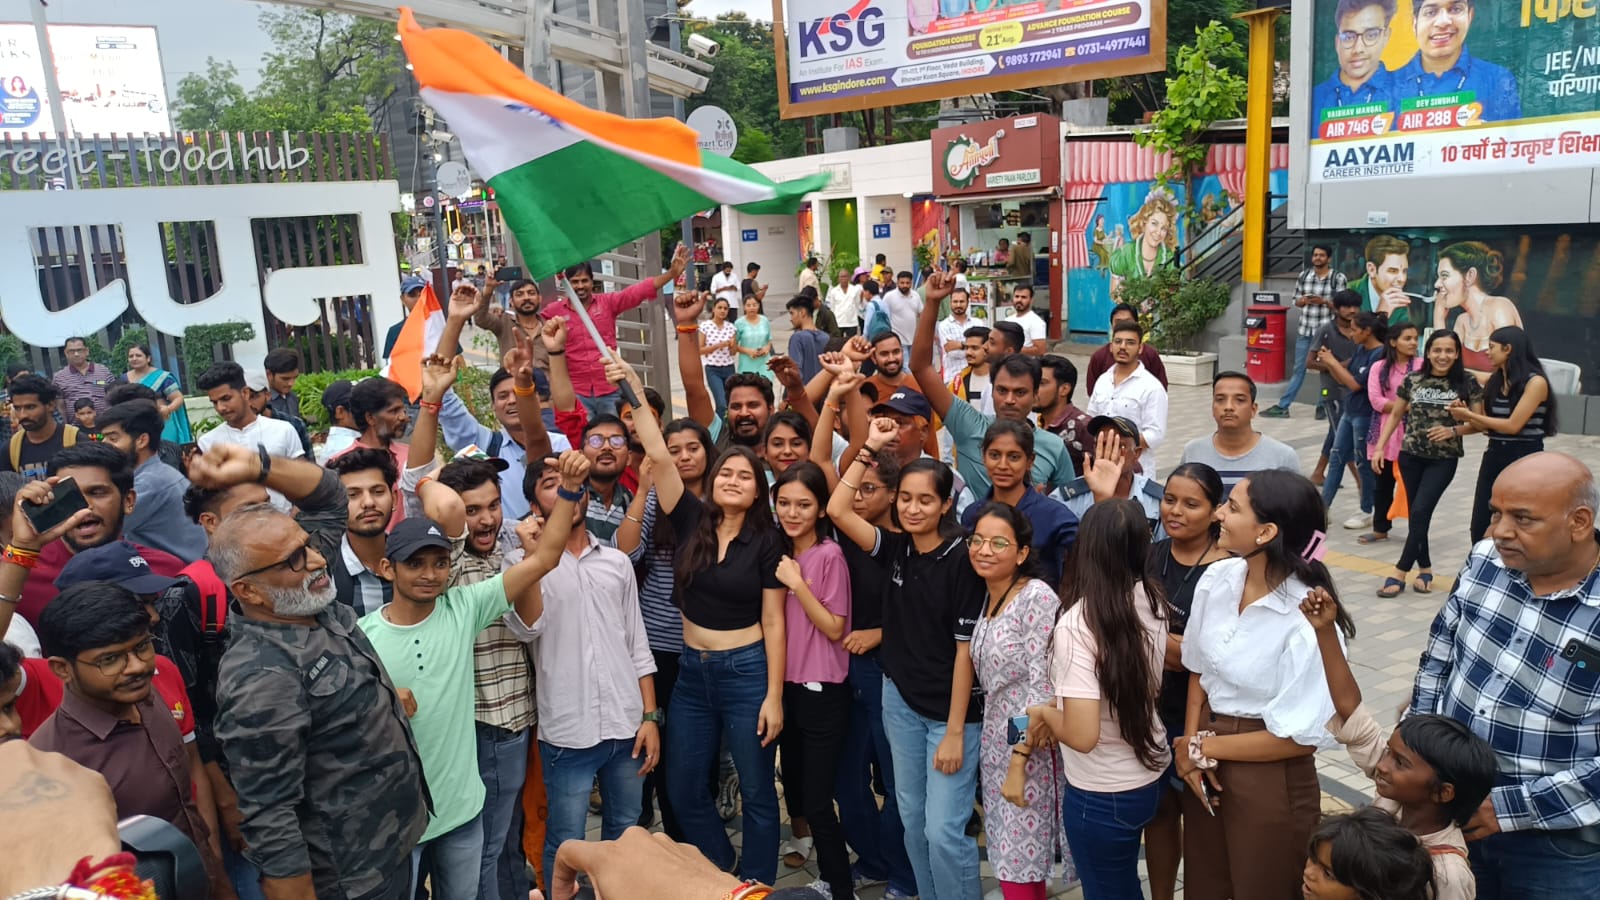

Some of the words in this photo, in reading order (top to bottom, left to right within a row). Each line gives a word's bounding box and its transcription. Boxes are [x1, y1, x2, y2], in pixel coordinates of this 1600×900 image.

[1026, 21, 1058, 32] ADVANCE
[1058, 11, 1101, 26] FOUNDATION
[1102, 6, 1131, 18] COURSE
[798, 7, 885, 58] KSG
[911, 38, 951, 51] FOUNDATION
[951, 33, 977, 44] COURSE
[1005, 52, 1028, 67] 9893
[1029, 48, 1062, 64] 772941
[1077, 34, 1147, 56] 0731-4977441
[1543, 44, 1600, 75] JEE/N
[844, 57, 863, 70] IAS
[799, 76, 886, 96] www.ksgindore.com
[1547, 73, 1600, 98] परिणा
[1326, 107, 1354, 118] VAIBHAV
[1355, 104, 1383, 114] MANDAL
[1415, 99, 1429, 108] DEV
[1325, 122, 1346, 138] AIR
[1347, 118, 1370, 136] 746
[1402, 113, 1424, 130] AIR
[1426, 109, 1452, 127] 288
[717, 140, 734, 148] City
[1440, 145, 1458, 163] 10
[1491, 137, 1508, 159] से
[1325, 142, 1415, 168] AAYAM
[1322, 166, 1361, 179] CAREER
[1363, 162, 1415, 176] INSTITUTE
